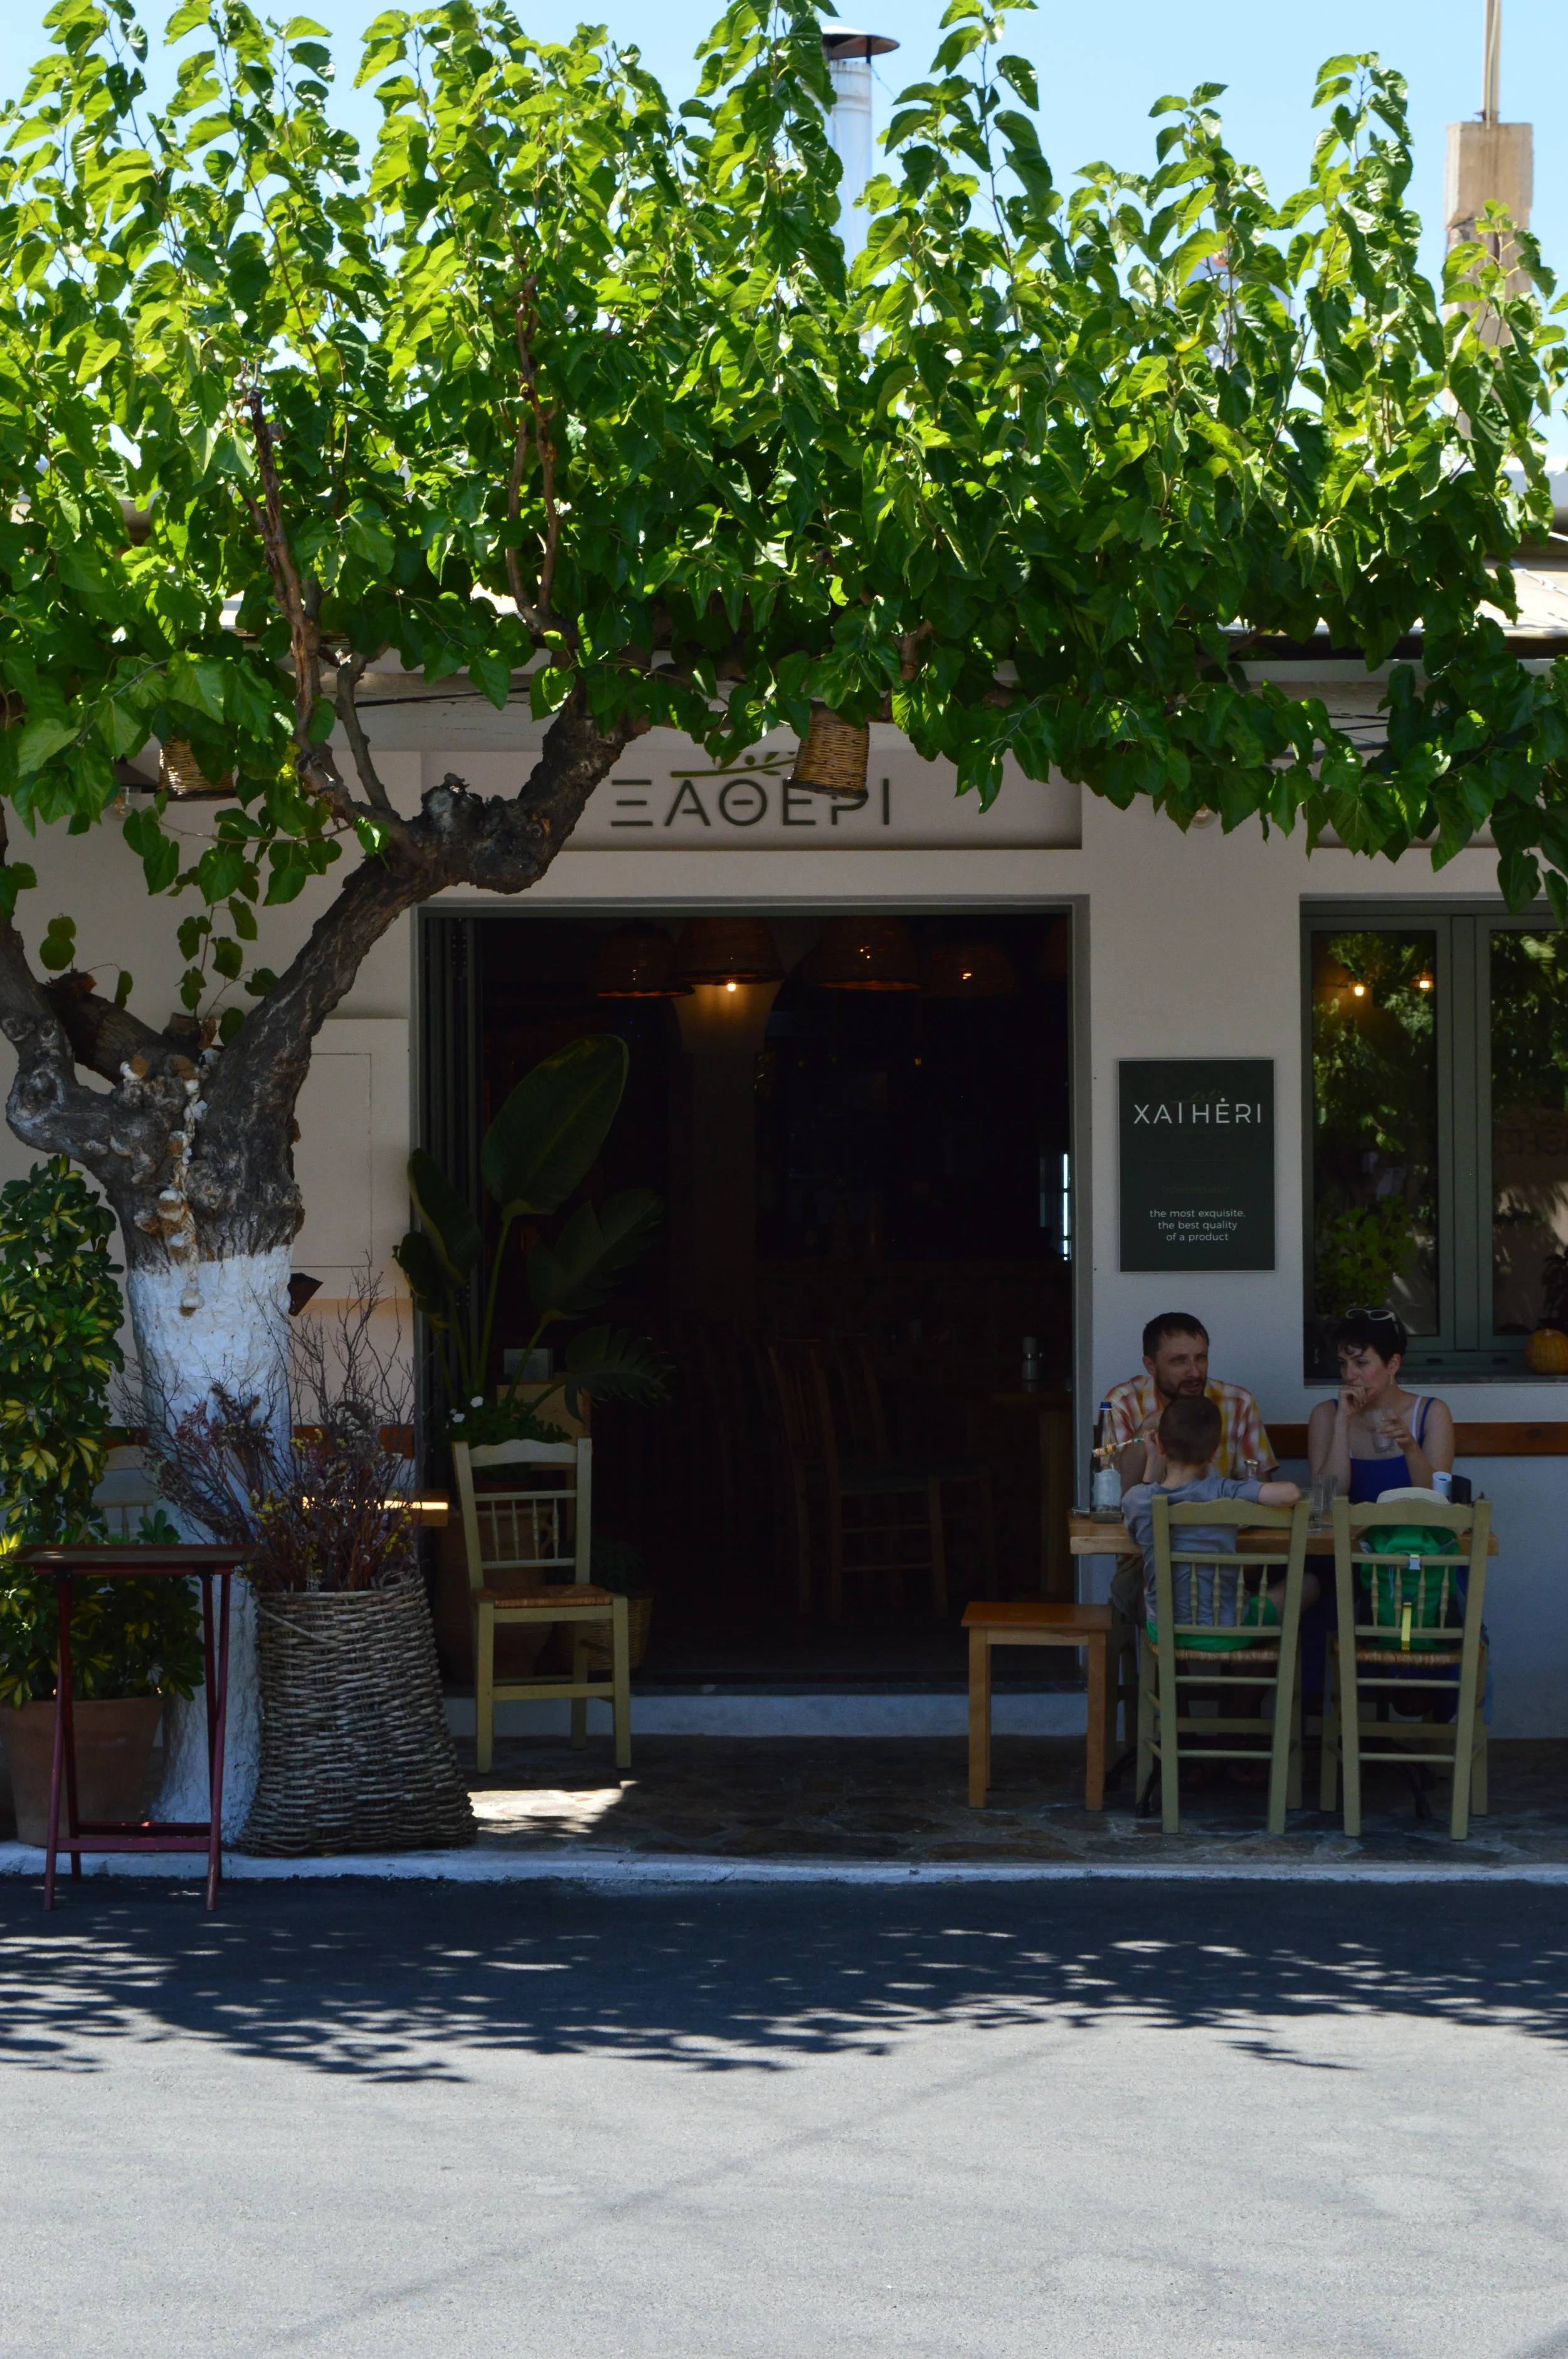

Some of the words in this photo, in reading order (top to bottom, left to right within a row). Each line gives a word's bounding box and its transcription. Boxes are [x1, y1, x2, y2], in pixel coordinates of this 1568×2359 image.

[1150, 1210, 1167, 1218] the
[1170, 1210, 1195, 1218] most
[1158, 1221, 1175, 1230] the
[1178, 1221, 1200, 1230] best
[1202, 1220, 1237, 1231] quality
[1166, 1233, 1177, 1241] of
[1189, 1233, 1229, 1243] product
